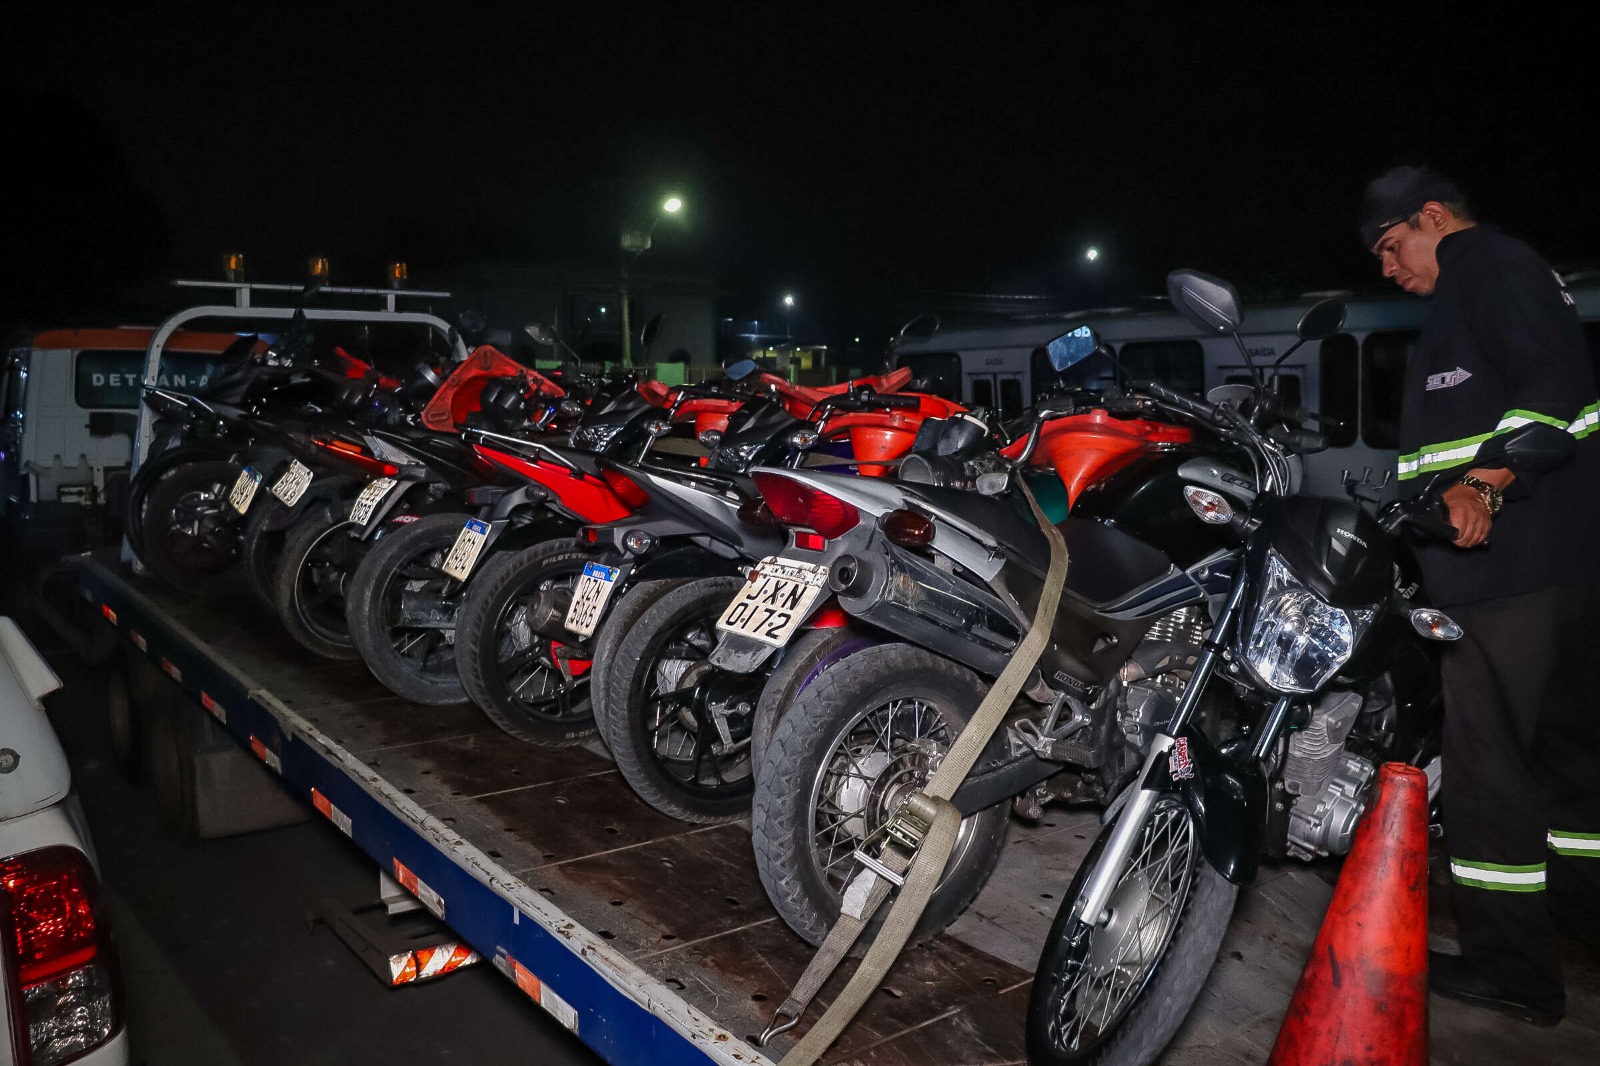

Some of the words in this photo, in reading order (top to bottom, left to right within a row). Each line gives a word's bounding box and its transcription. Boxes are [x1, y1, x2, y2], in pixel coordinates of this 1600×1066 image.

[92, 373, 209, 387] DETAN-A
[1336, 527, 1368, 549] HONDA
[725, 602, 791, 640] 0172
[1054, 671, 1084, 692] HONDA
